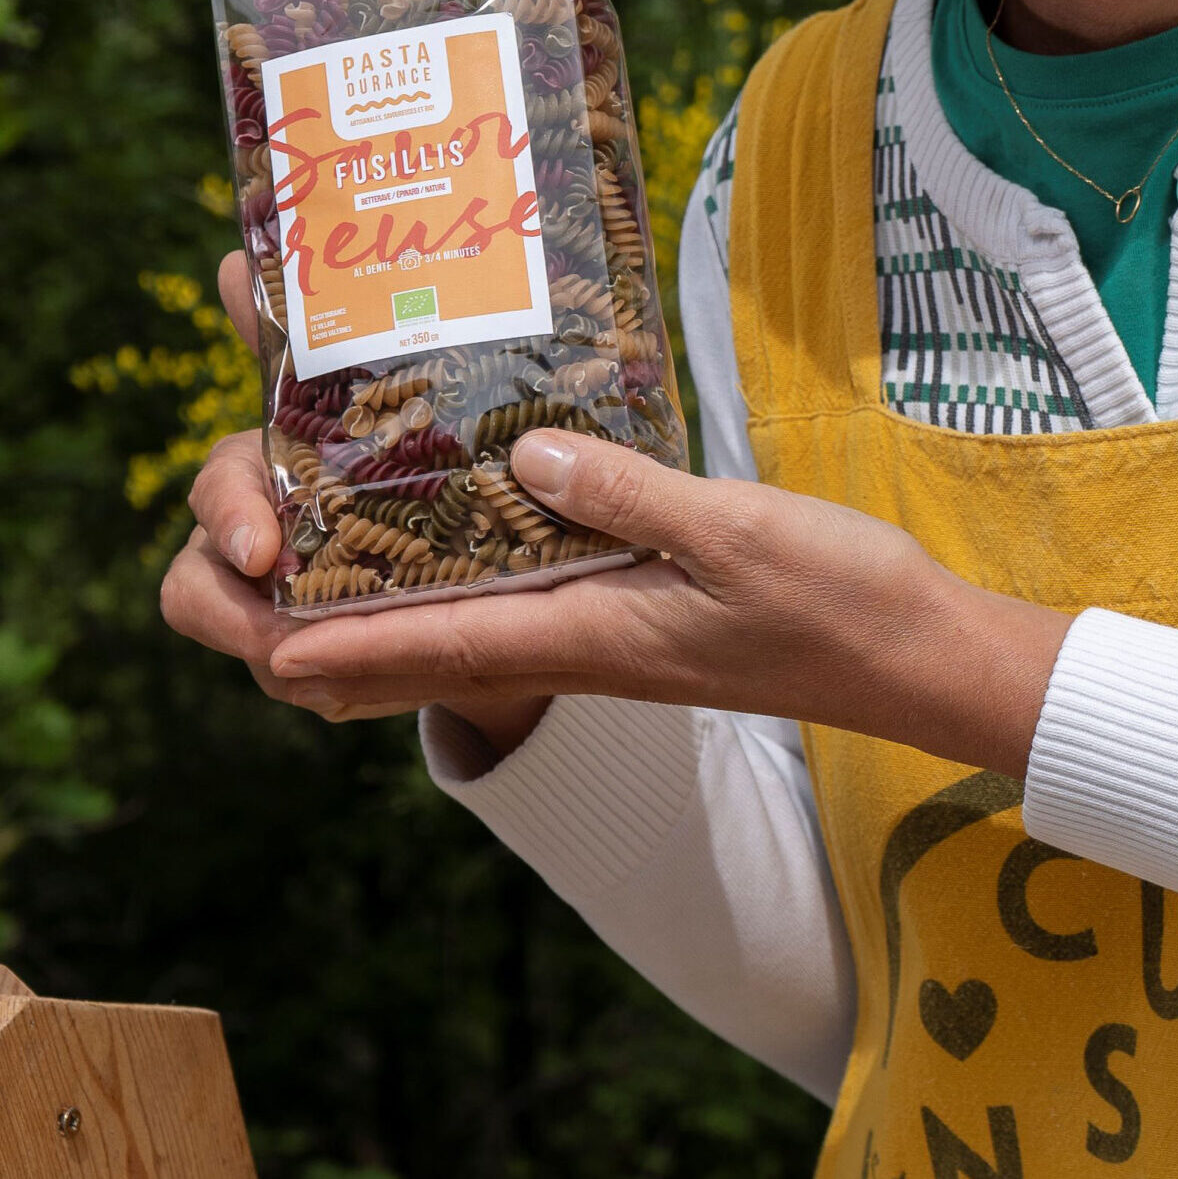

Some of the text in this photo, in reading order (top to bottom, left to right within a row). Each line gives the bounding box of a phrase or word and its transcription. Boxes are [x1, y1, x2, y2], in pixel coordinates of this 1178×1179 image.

[342, 41, 431, 80] PASTA
[346, 67, 432, 98] DURANCE
[335, 140, 466, 190] FUSILLIS
[361, 193, 391, 206] BETTERAVE
[424, 183, 446, 193] NATURE
[353, 245, 480, 279] AL DENTE 3/4 MINUTES
[399, 338, 410, 347] NET
[411, 331, 430, 345] 350
